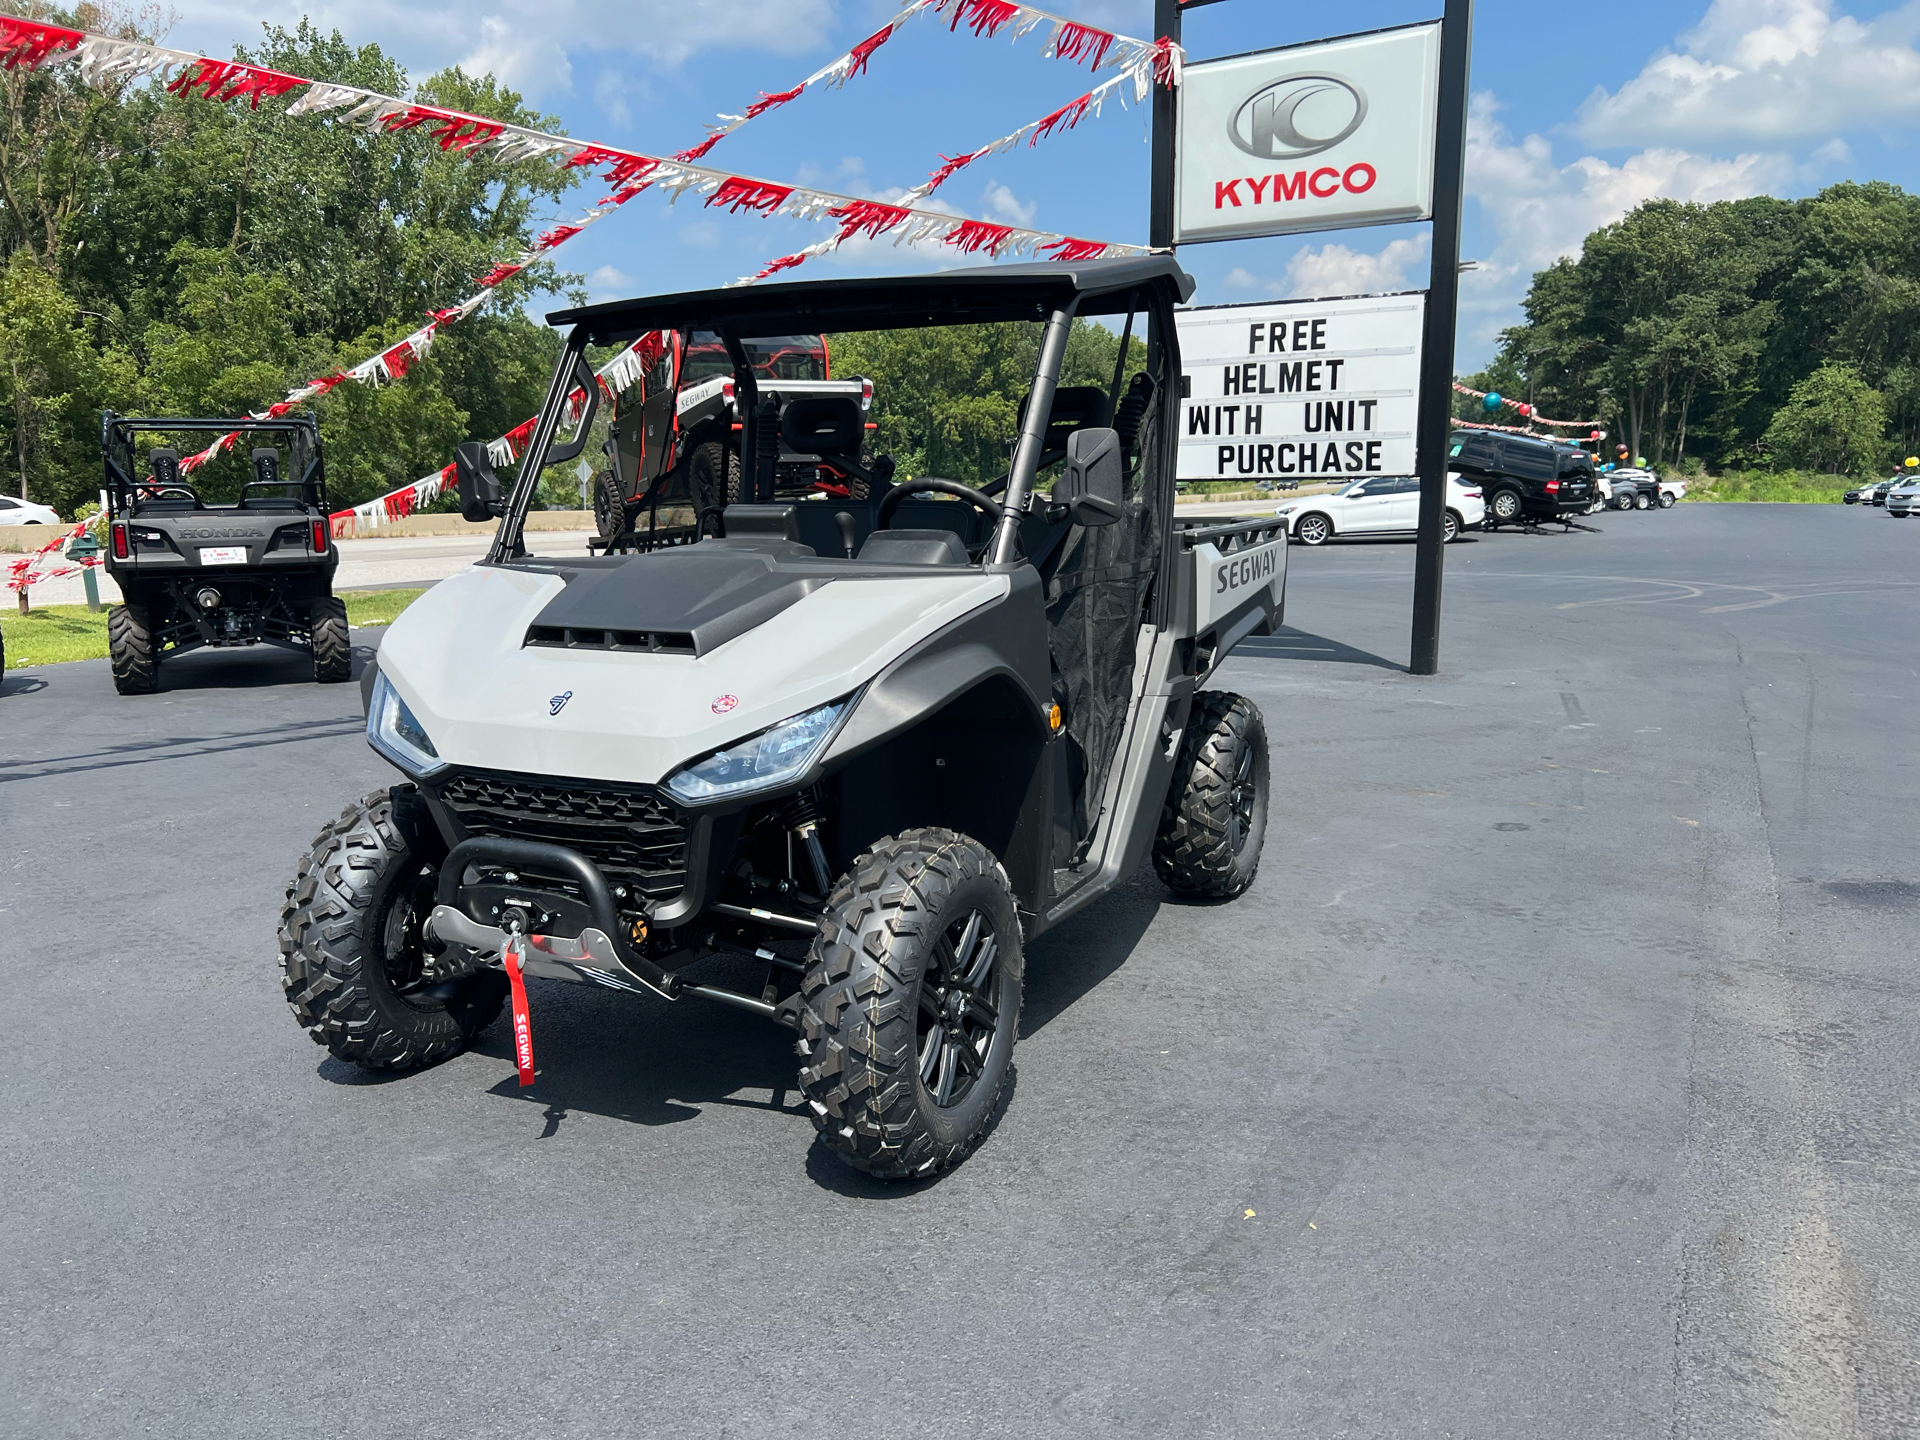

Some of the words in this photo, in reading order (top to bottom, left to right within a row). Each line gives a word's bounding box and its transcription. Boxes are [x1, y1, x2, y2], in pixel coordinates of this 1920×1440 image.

[1214, 163, 1378, 209] KYMCO
[1249, 318, 1327, 354] FREE
[1223, 359, 1345, 396] HELMET
[681, 387, 710, 409] SEGWAY
[1188, 405, 1262, 436] WITH
[1304, 400, 1378, 433] UNIT
[1218, 440, 1382, 475] PURCHASE
[178, 527, 265, 539] HONDA
[1217, 548, 1278, 594] SEGWAY
[516, 1013, 531, 1069] SEGWAY
